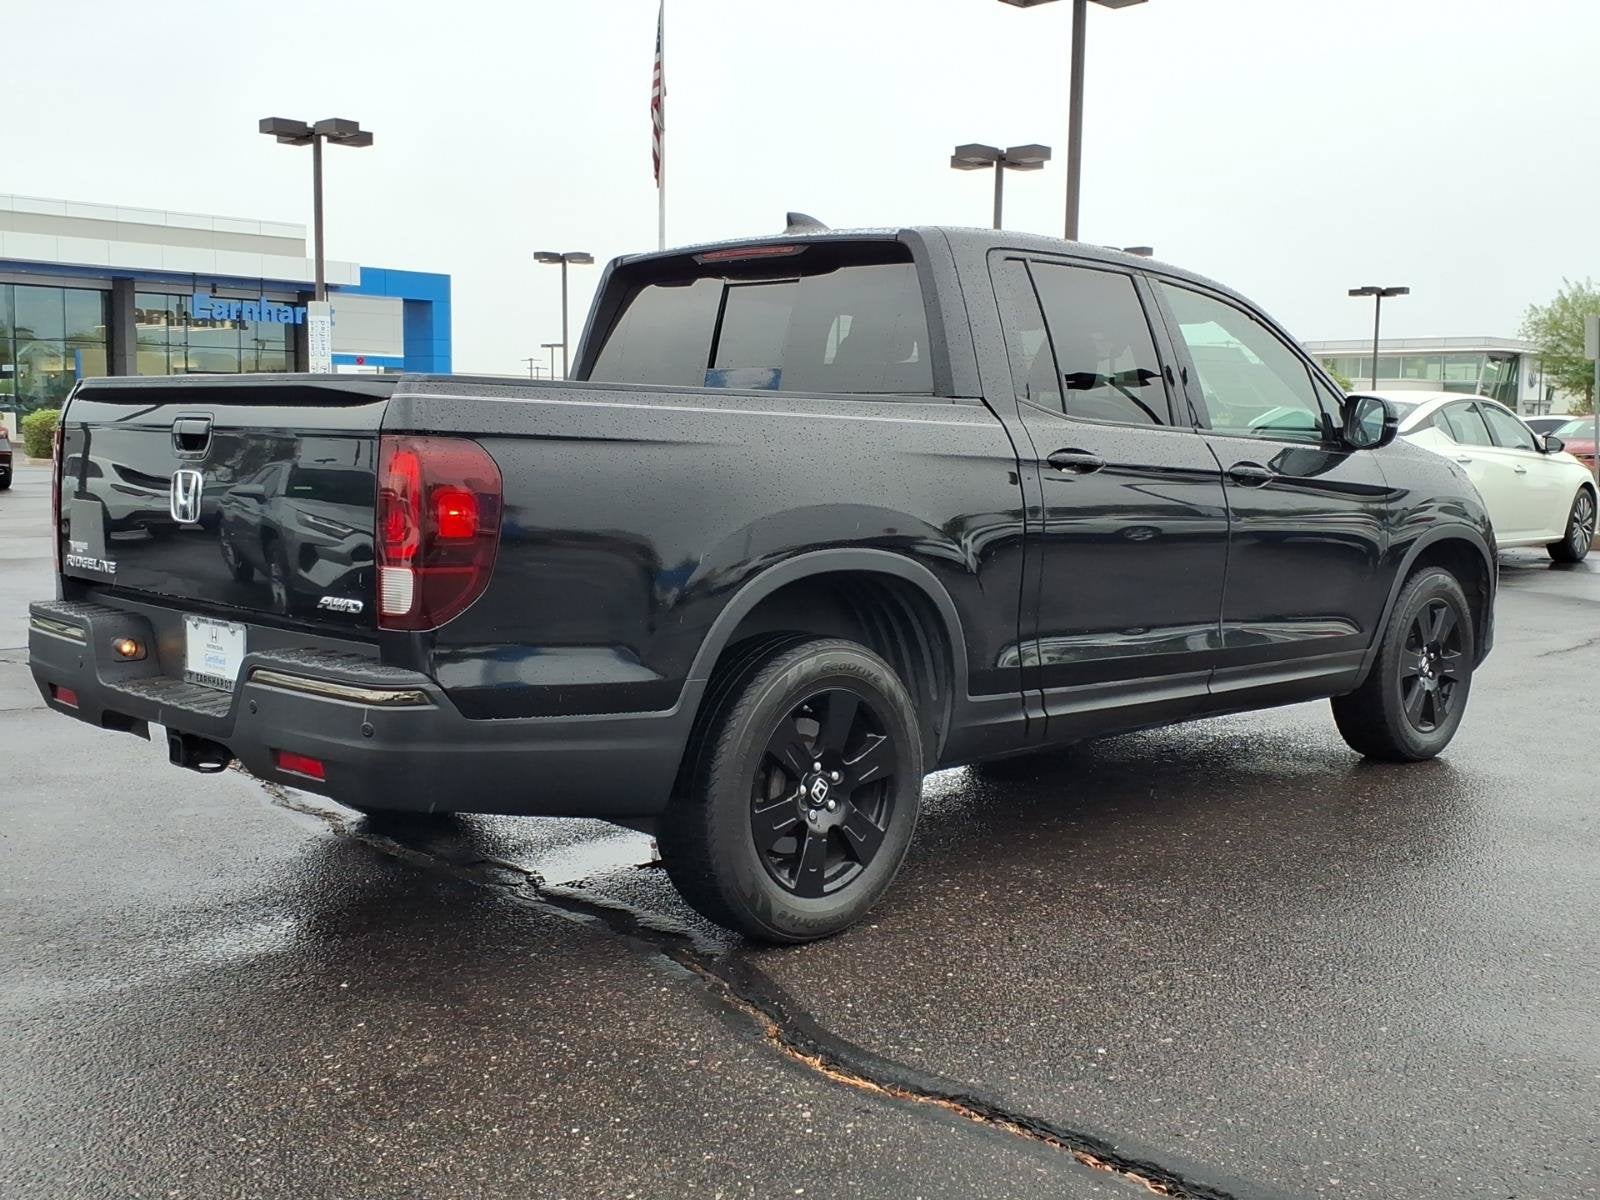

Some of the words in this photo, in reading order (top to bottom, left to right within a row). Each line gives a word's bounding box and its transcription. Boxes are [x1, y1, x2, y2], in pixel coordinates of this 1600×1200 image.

[192, 292, 336, 326] Earnhar
[67, 554, 117, 573] RIDGELINE
[317, 596, 364, 613] AWD
